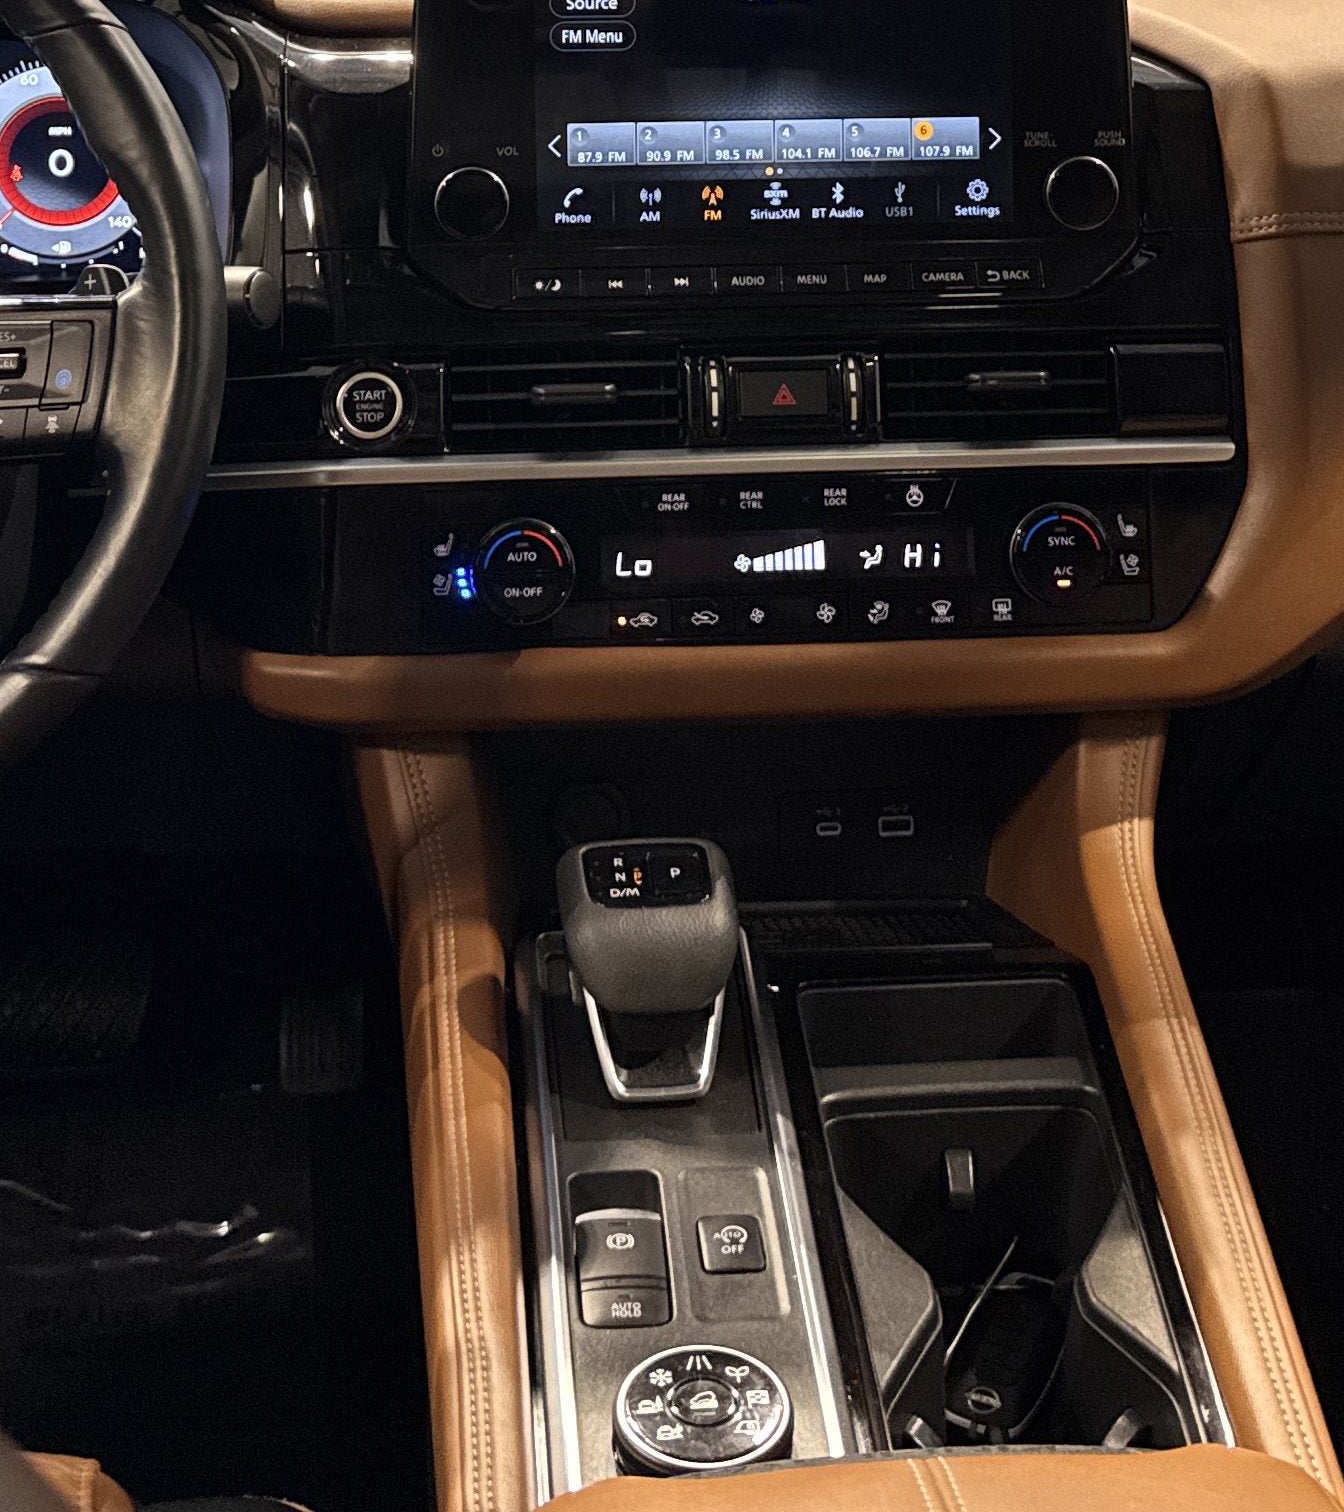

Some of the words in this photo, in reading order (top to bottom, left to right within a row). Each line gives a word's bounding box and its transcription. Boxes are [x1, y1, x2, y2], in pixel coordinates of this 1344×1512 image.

[561, 29, 582, 44] FM
[585, 28, 623, 44] Menu
[19, 74, 40, 86] 60
[48, 126, 72, 136] MPH
[1097, 131, 1122, 139] PUSH
[1024, 139, 1057, 148] SCROLL
[1094, 138, 1126, 147] SOUND
[496, 146, 518, 156] VOL
[646, 151, 671, 162] 90.9
[677, 150, 694, 161] FM
[715, 149, 740, 161] 98.5
[745, 148, 763, 160] FM
[781, 148, 812, 160] 104.1
[818, 147, 836, 158] FM
[850, 147, 880, 158] 106.7
[887, 146, 904, 158] FM
[920, 146, 950, 157] 107.9
[956, 145, 974, 156] FM
[577, 151, 603, 163] 87.9
[608, 151, 626, 162] FM
[48, 148, 74, 178] 0
[640, 211, 661, 222] AM
[704, 210, 722, 221] FM
[750, 208, 800, 220] SiriusXM
[812, 207, 826, 219] BT
[829, 207, 864, 219] Audio
[885, 206, 914, 218] USB1
[954, 204, 1001, 218] Settings
[107, 215, 132, 228] 140
[555, 212, 592, 224] Phone
[731, 275, 765, 286] AUDIO
[797, 274, 827, 285] MENU
[864, 274, 887, 284] MAP
[922, 271, 964, 282] CAMERA
[1002, 269, 1030, 281] BACK
[353, 390, 386, 401] START
[356, 412, 384, 423] STOP
[661, 493, 686, 503] REAR
[739, 491, 764, 501] REAR
[823, 488, 847, 497] REAR
[739, 500, 763, 510] CTRL
[823, 496, 847, 507] LOCK
[1047, 535, 1076, 547] SYNC
[507, 552, 537, 561] AUTO
[903, 543, 942, 568] Hi
[615, 552, 653, 577] Lo
[1053, 565, 1074, 576] A/C
[931, 615, 955, 625] FRONT
[992, 613, 1012, 622] REAR
[613, 857, 624, 867] R
[614, 872, 626, 882] N
[670, 867, 681, 879] P
[609, 887, 640, 898] D/M
[721, 1245, 744, 1255] OFF
[610, 1302, 641, 1310] AUTO
[611, 1309, 642, 1318] HOLD
